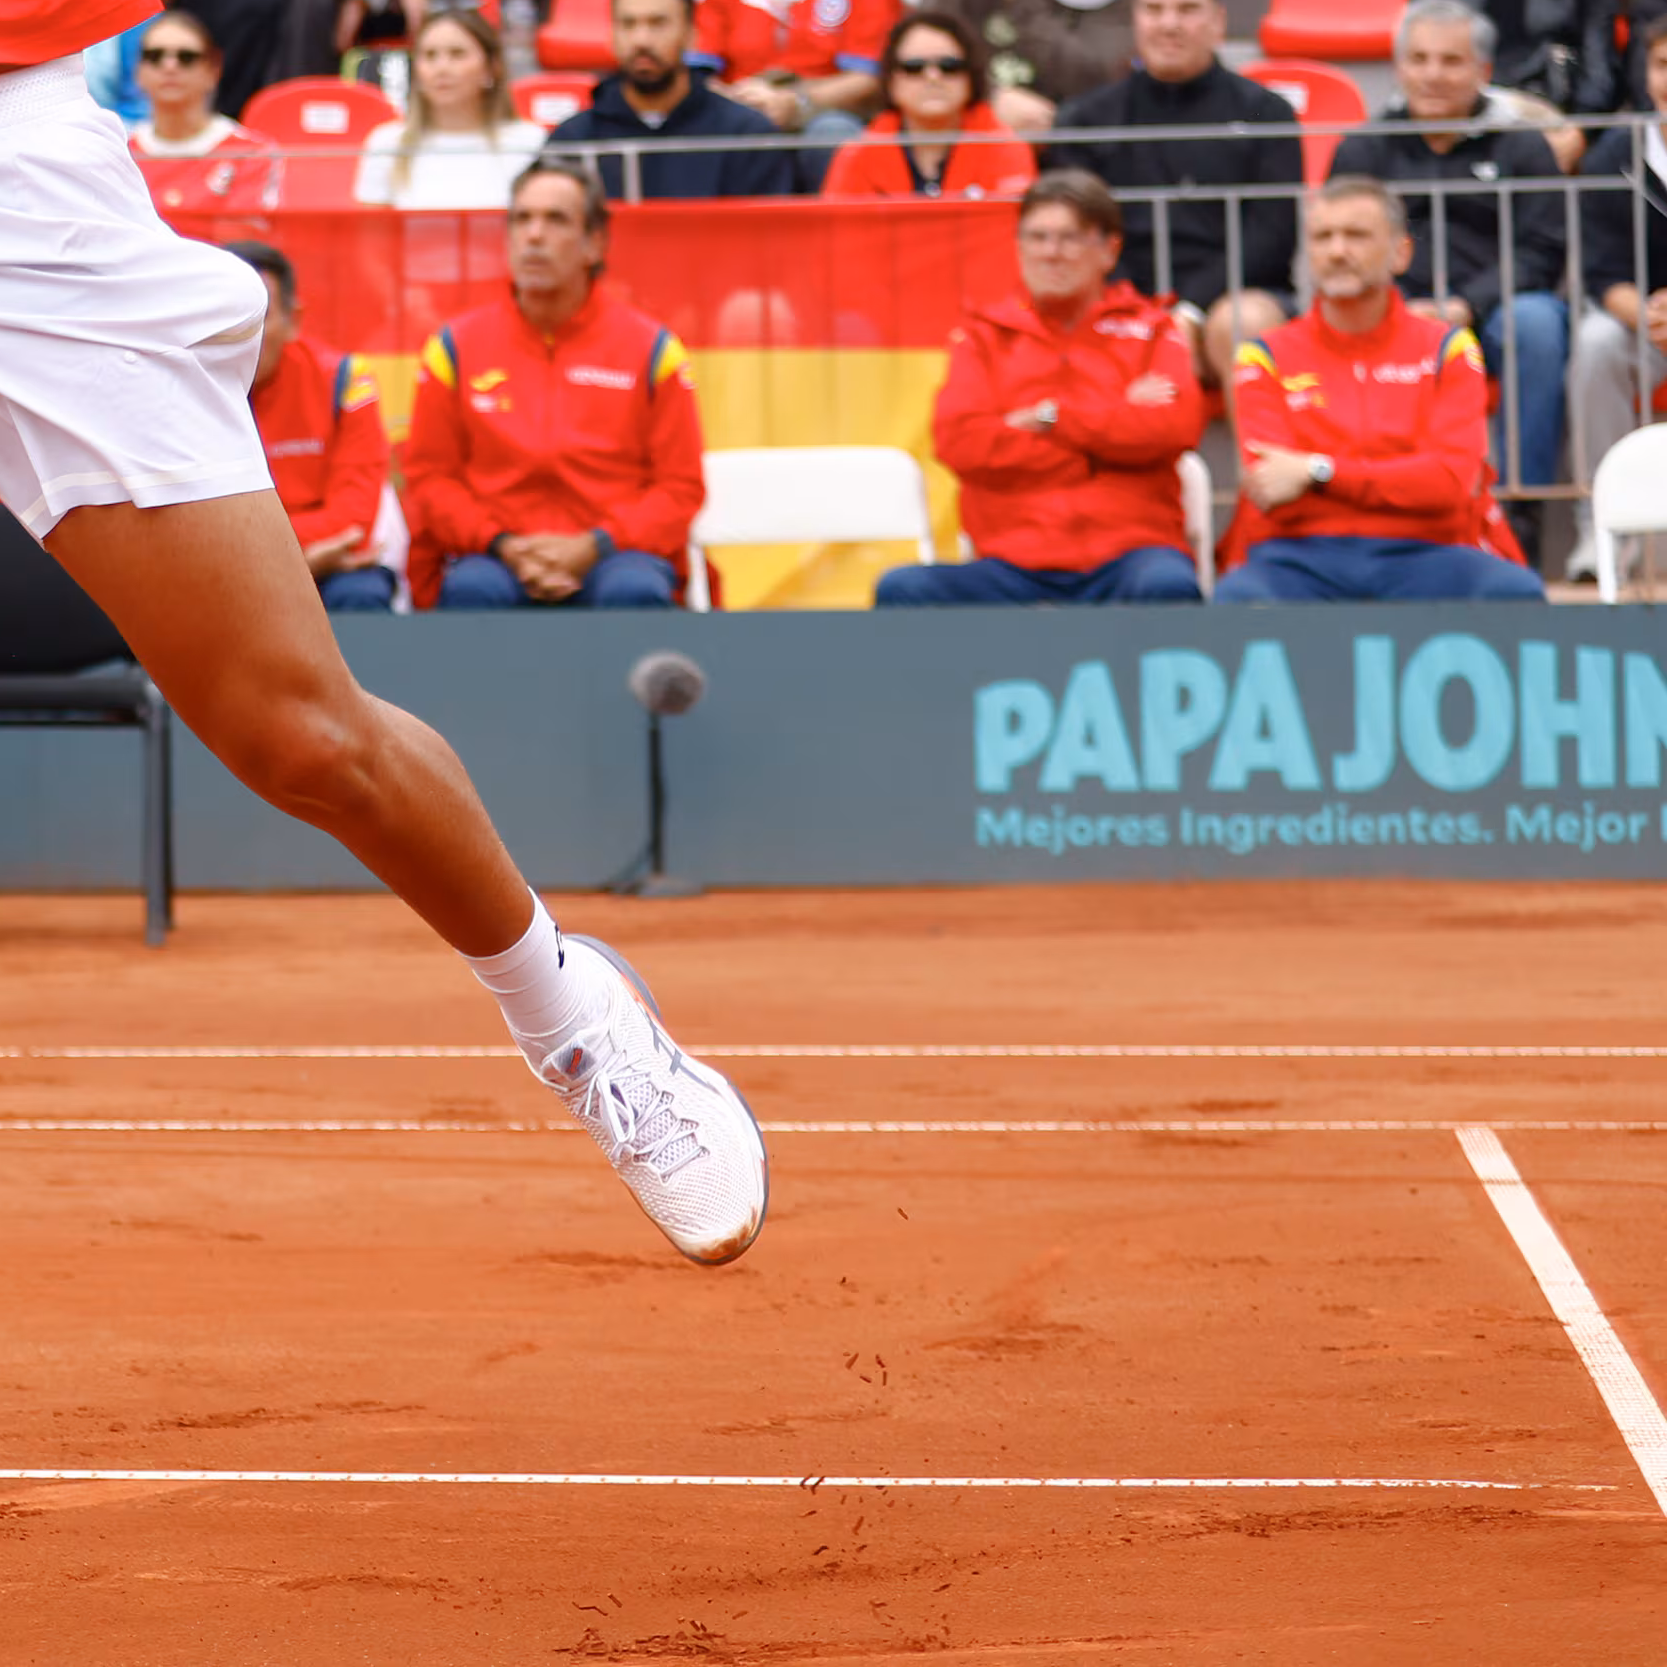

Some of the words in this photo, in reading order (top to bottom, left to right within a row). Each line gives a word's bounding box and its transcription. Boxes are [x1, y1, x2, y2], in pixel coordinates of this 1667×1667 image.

[974, 640, 1322, 792] PAPA
[974, 805, 1167, 855] Mejores
[1178, 802, 1493, 854] Ingredientes.
[1505, 799, 1648, 854] Mejor
